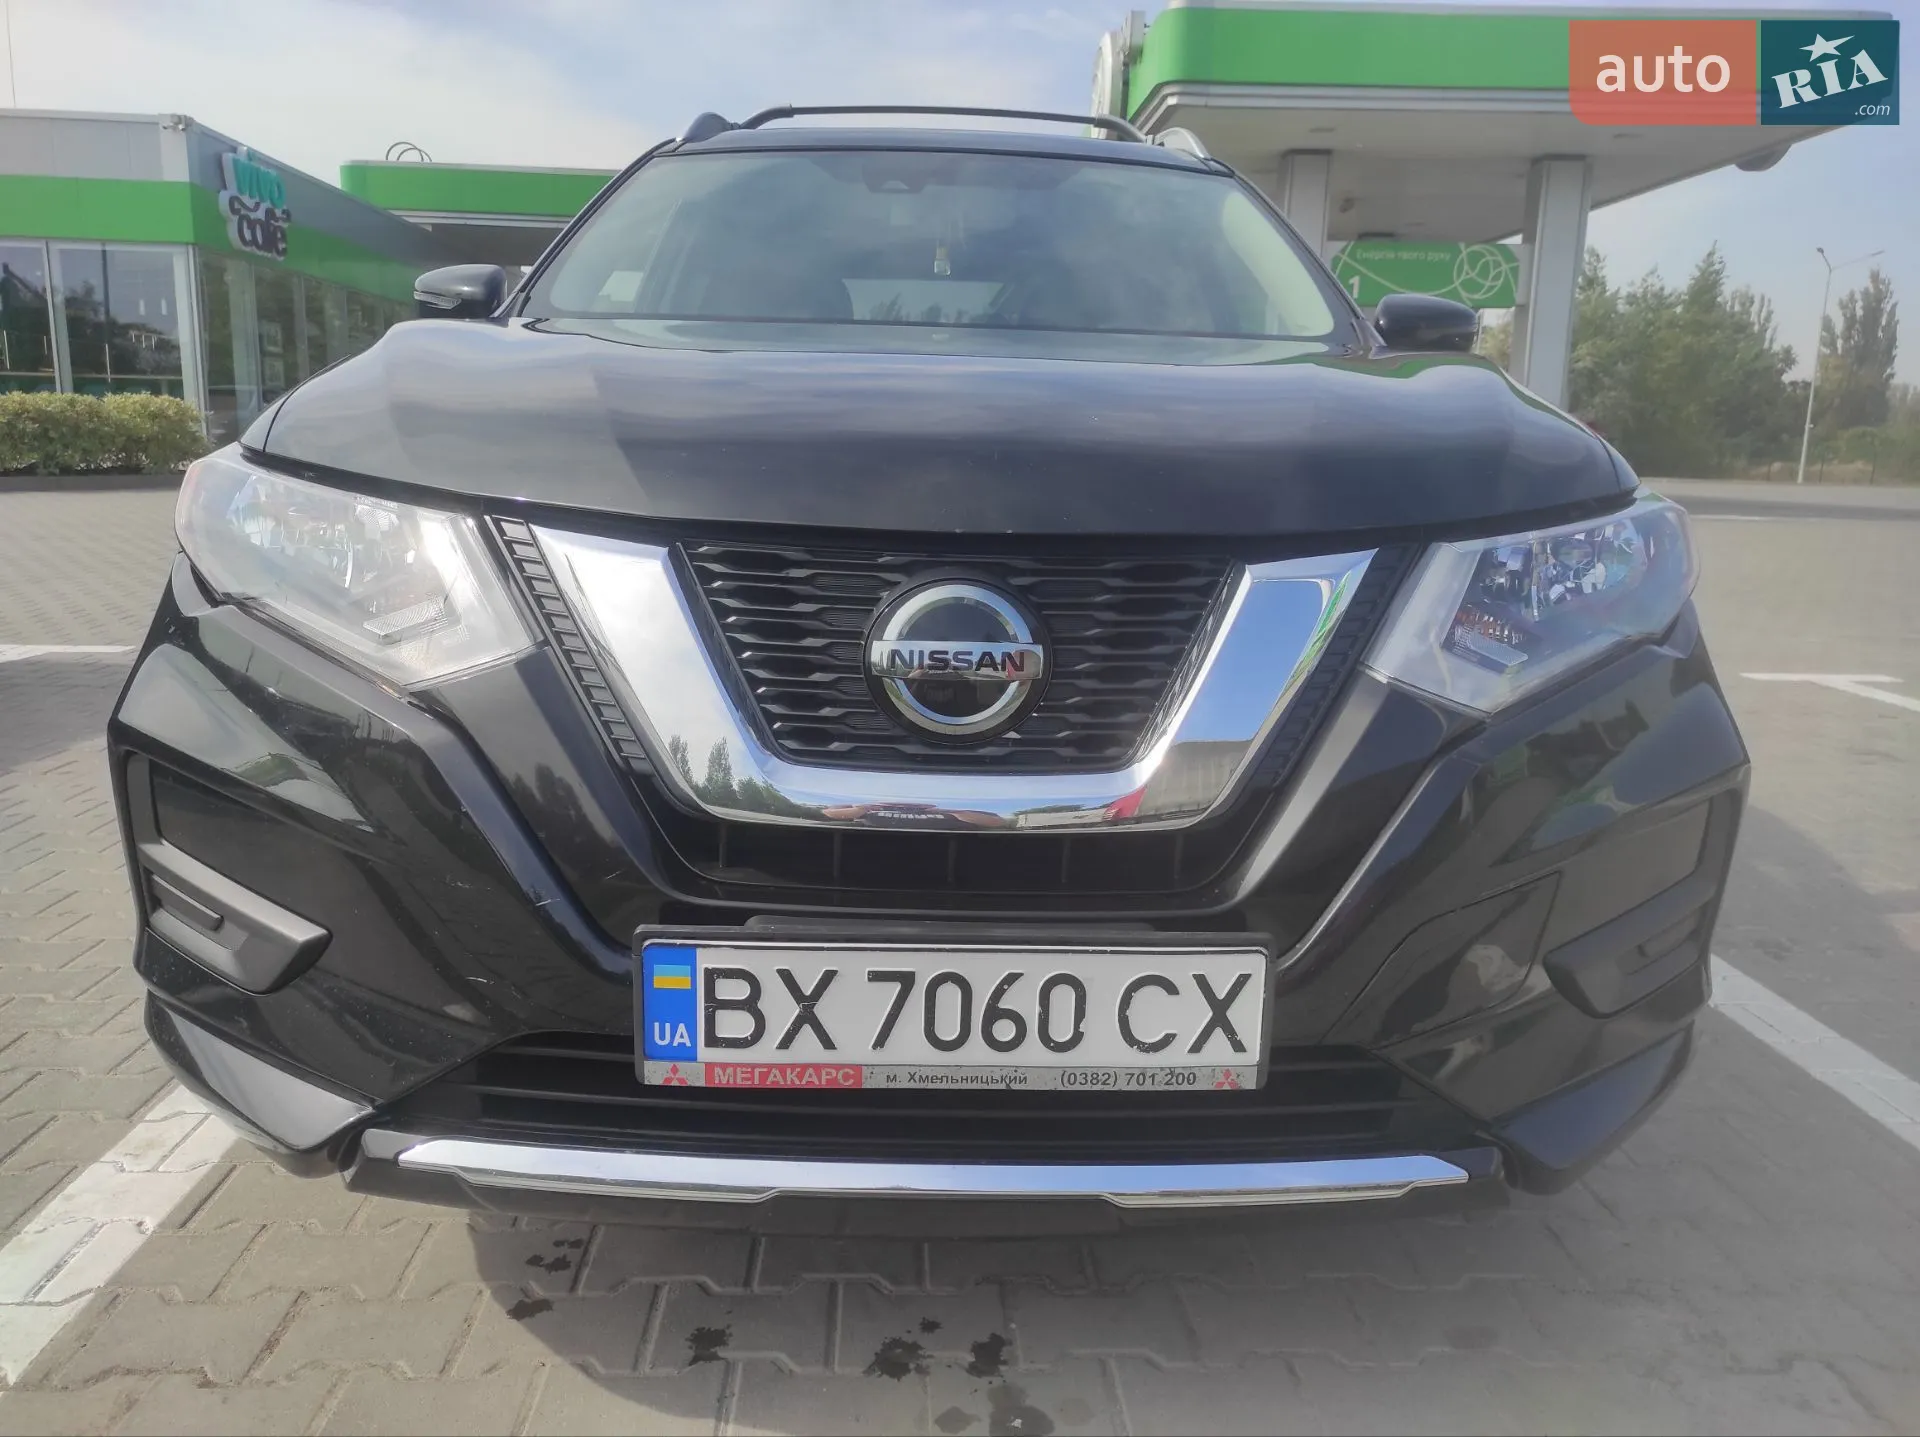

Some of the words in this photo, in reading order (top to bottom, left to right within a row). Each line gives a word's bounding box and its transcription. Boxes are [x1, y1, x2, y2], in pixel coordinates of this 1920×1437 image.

[1348, 275, 1360, 299] 1
[890, 648, 1025, 672] NISSAN
[703, 965, 838, 1051] BX
[867, 969, 1087, 1054] 7060
[1116, 972, 1253, 1055] CX
[653, 1022, 692, 1048] UA
[714, 1066, 855, 1087] МЕГАКАРС
[885, 1073, 902, 1085] м.
[906, 1070, 1028, 1087] Хмельницький
[1060, 1070, 1119, 1088] (0382)
[1125, 1070, 1157, 1087] 701
[1164, 1070, 1197, 1087] 200
